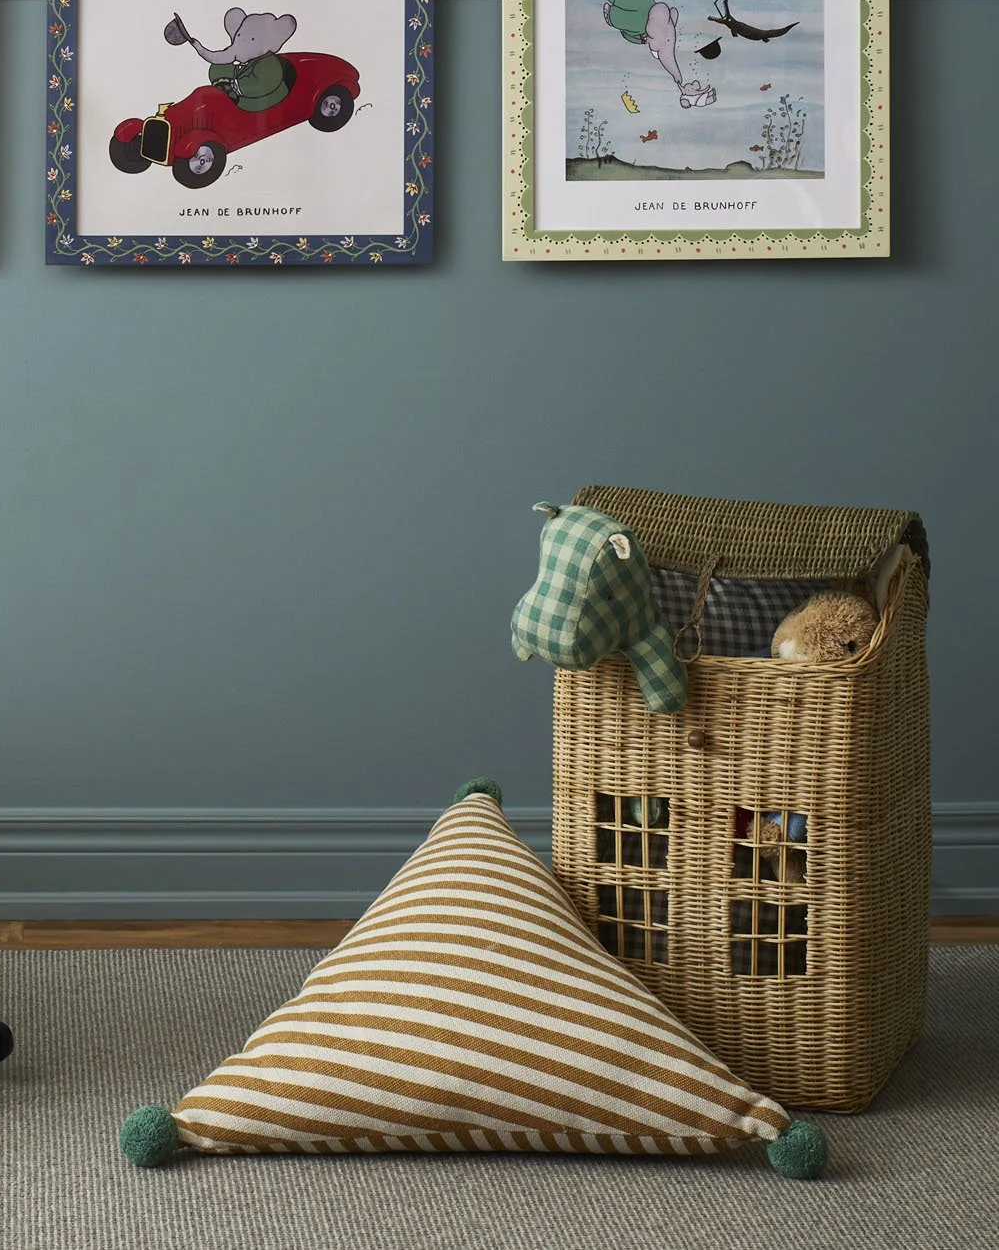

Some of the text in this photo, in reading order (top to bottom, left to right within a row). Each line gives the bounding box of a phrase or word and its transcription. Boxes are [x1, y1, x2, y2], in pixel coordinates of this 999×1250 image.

[634, 201, 758, 211] JEAN DE BRUNHOFF
[178, 207, 302, 217] JEAN DE BRUNHOFF
